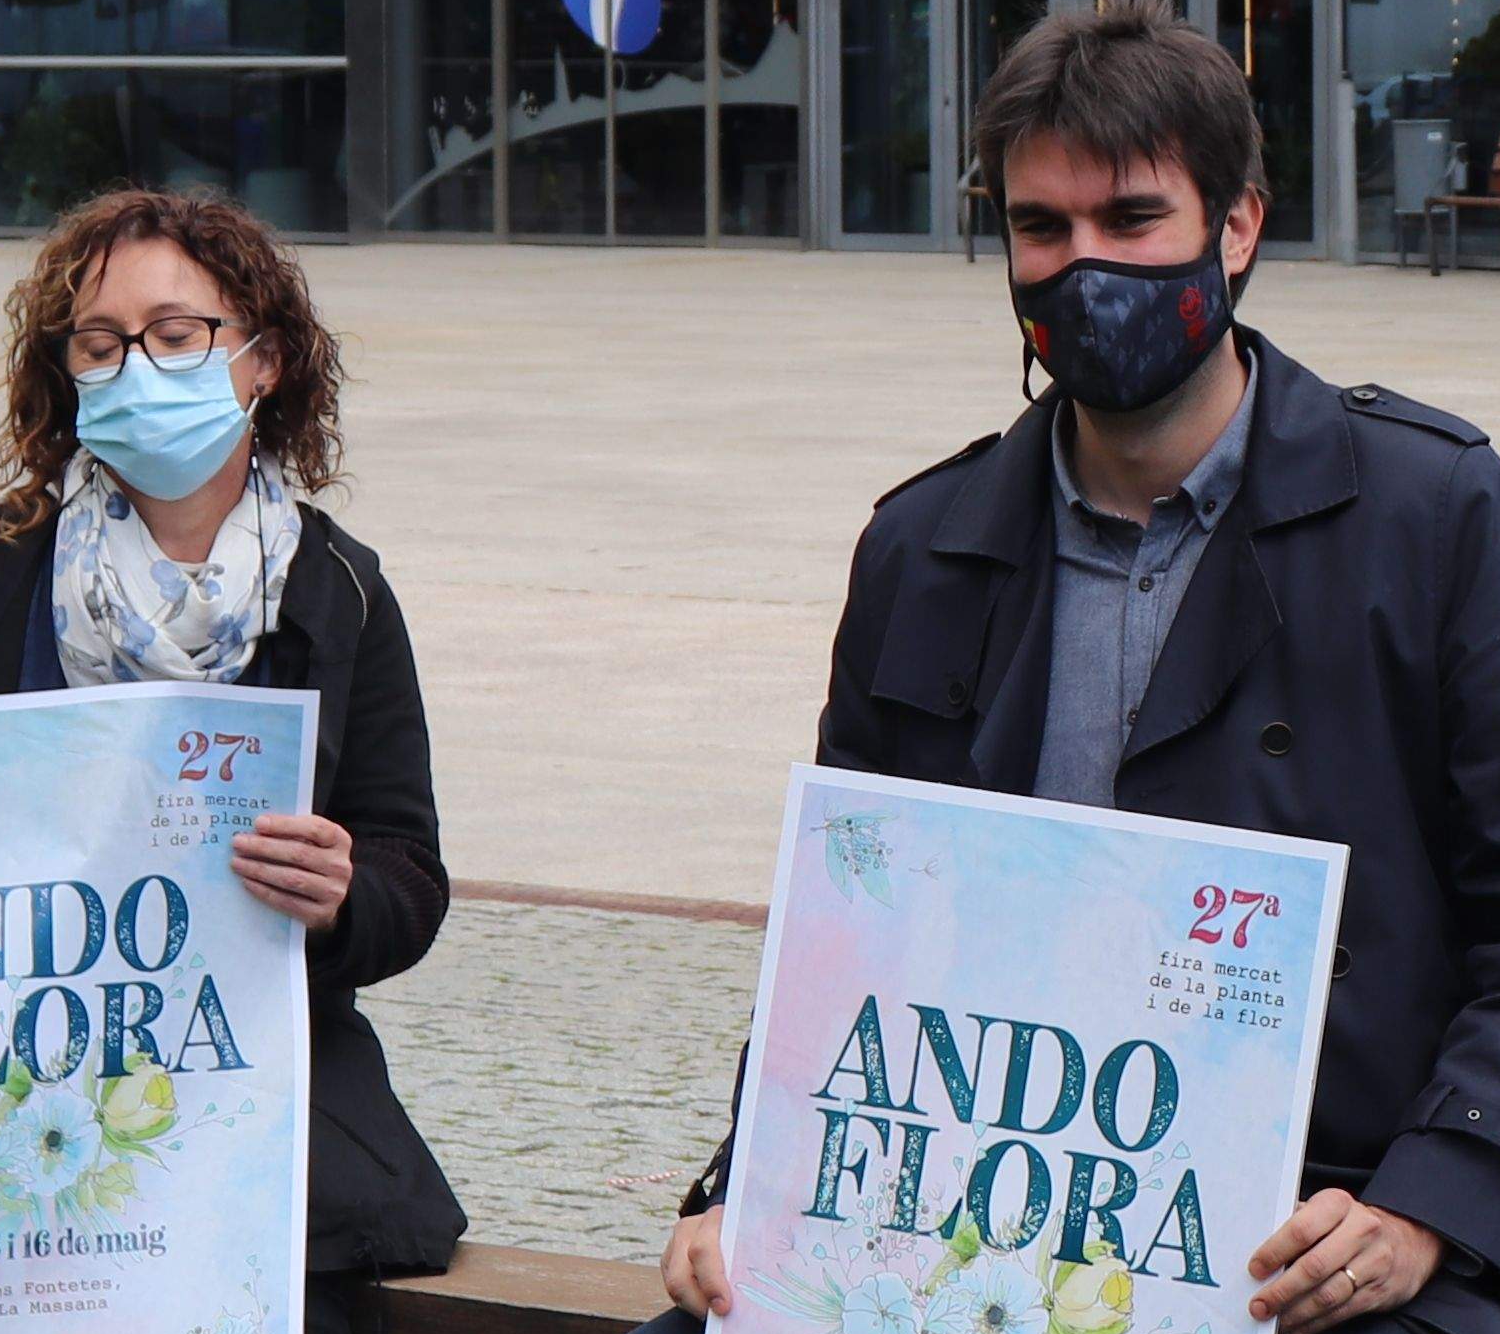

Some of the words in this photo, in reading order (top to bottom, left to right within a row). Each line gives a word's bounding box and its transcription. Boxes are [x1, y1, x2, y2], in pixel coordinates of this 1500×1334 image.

[156, 794, 194, 808] fira
[205, 795, 270, 809] mercat
[151, 814, 170, 827] de
[181, 813, 199, 825] la
[210, 811, 253, 827] plan
[151, 832, 159, 847] i
[170, 833, 189, 846] de
[201, 832, 219, 844] la
[1160, 951, 1203, 971] fira
[1214, 961, 1283, 984] mercat
[1150, 973, 1172, 988] de
[1184, 978, 1206, 995] la
[1217, 984, 1285, 1007] planta
[1147, 993, 1156, 1009] i
[1169, 998, 1191, 1014] de
[1203, 1003, 1225, 1021] la
[1237, 1009, 1282, 1029] flor
[810, 994, 1180, 1152] ANDO
[801, 1108, 1220, 1288] FLORA
[7, 1232, 15, 1259] i
[22, 1229, 51, 1258] 16
[57, 1227, 89, 1256] de
[95, 1223, 167, 1257] maig
[24, 1277, 122, 1296] Fontetes,
[29, 1298, 108, 1314] Massana
